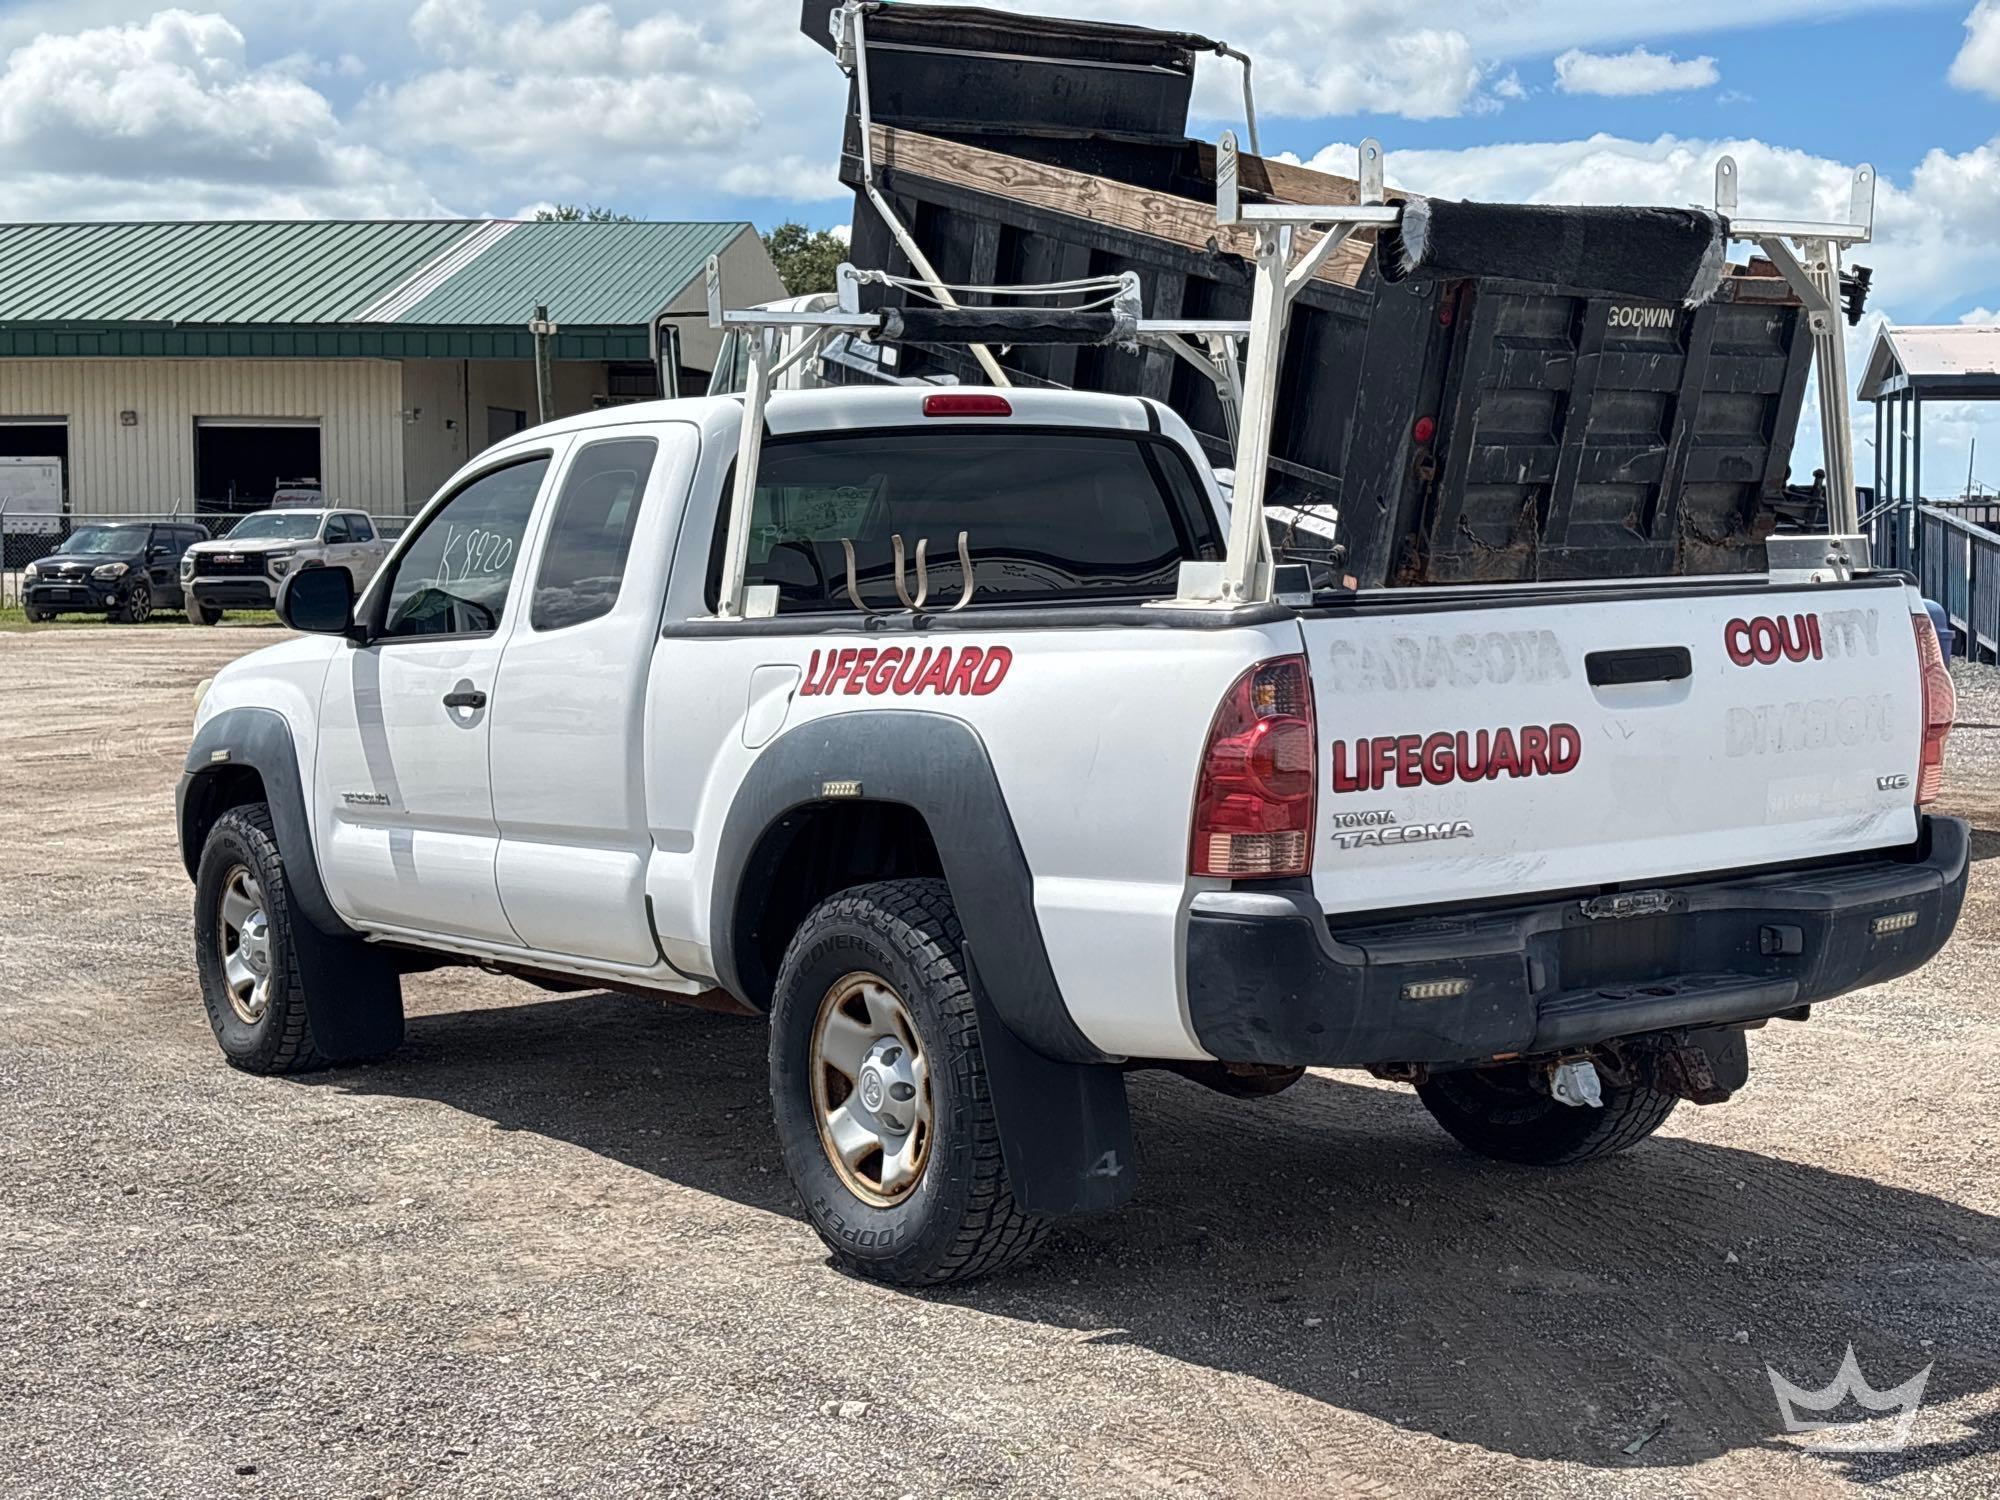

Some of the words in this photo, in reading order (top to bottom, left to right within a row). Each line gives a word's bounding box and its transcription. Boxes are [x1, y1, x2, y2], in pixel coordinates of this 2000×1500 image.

[1609, 307, 1675, 327] GODWIN
[459, 528, 513, 583] 8920
[800, 646, 1013, 696] LIFEGUARD
[1332, 723, 1582, 793] LIFEGUARD
[1876, 774, 1910, 791] V6
[1333, 810, 1397, 828] TOYOTA
[1331, 820, 1475, 850] TACOMA
